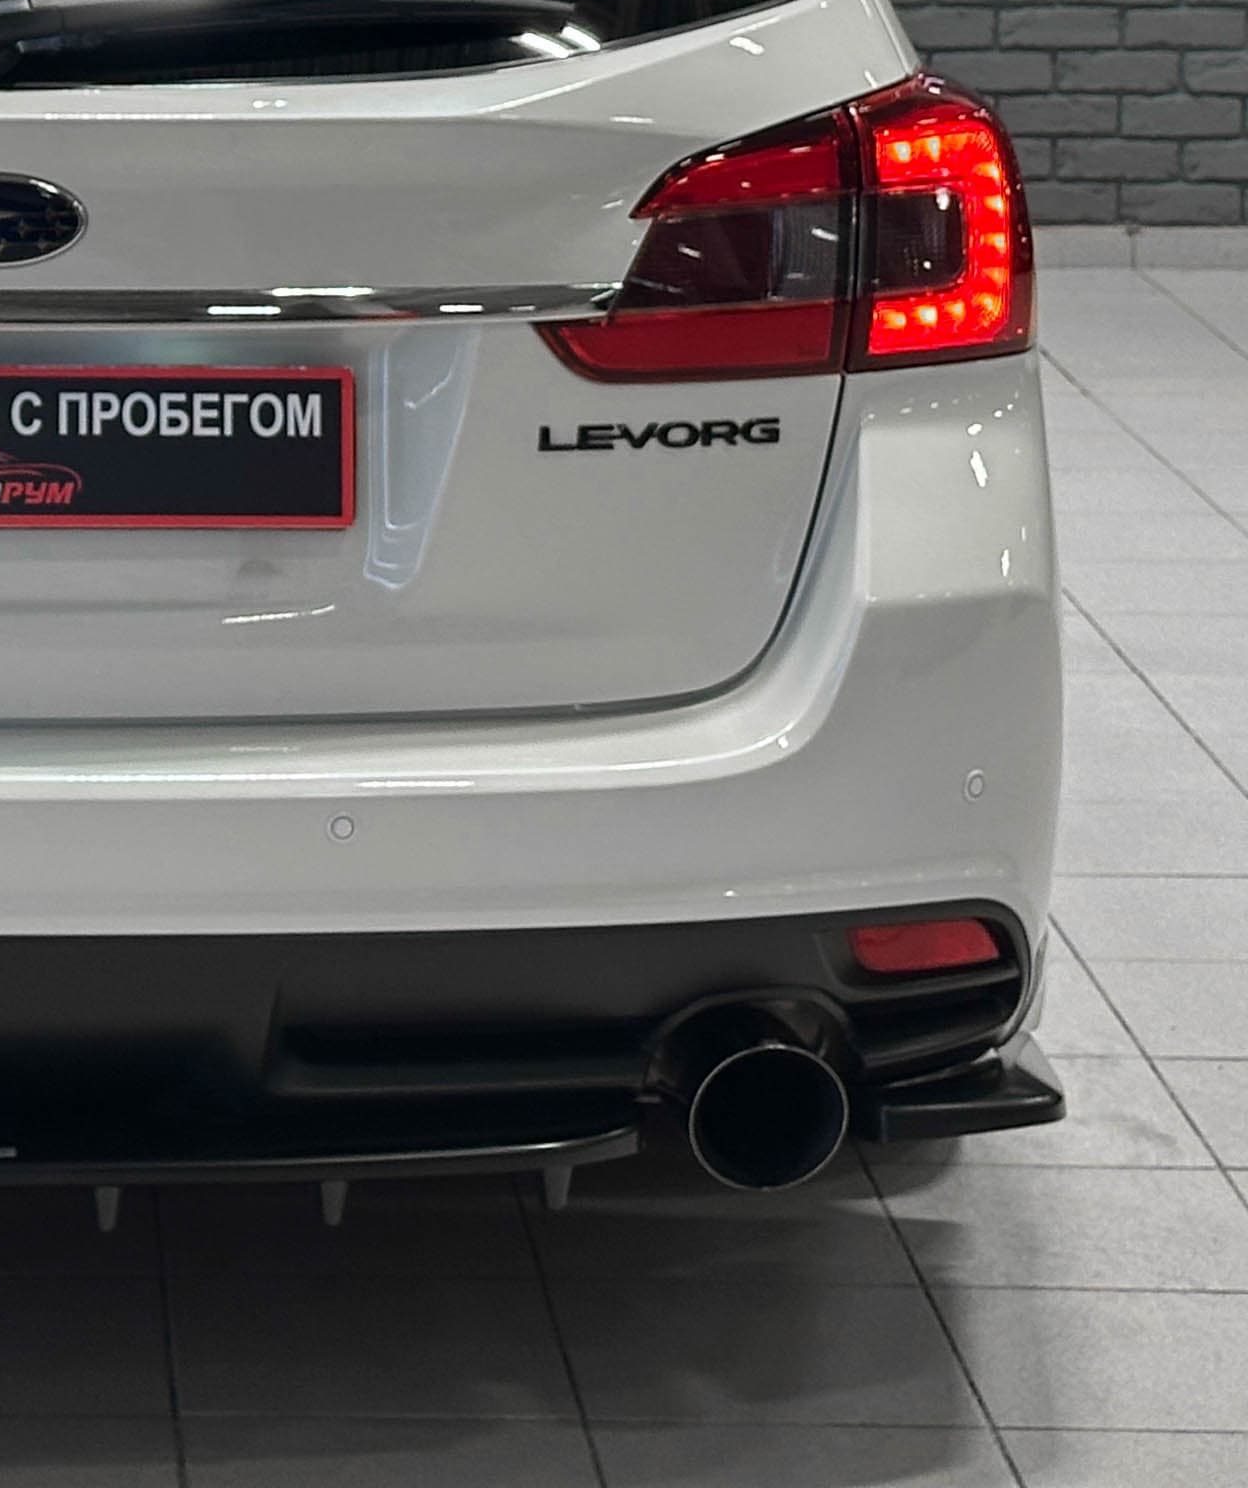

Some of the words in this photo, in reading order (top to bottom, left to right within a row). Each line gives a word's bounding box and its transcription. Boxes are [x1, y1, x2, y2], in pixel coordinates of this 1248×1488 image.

[11, 391, 43, 436] С
[58, 392, 323, 438] ПРОБЕГОМ
[538, 417, 780, 452] LEVORG
